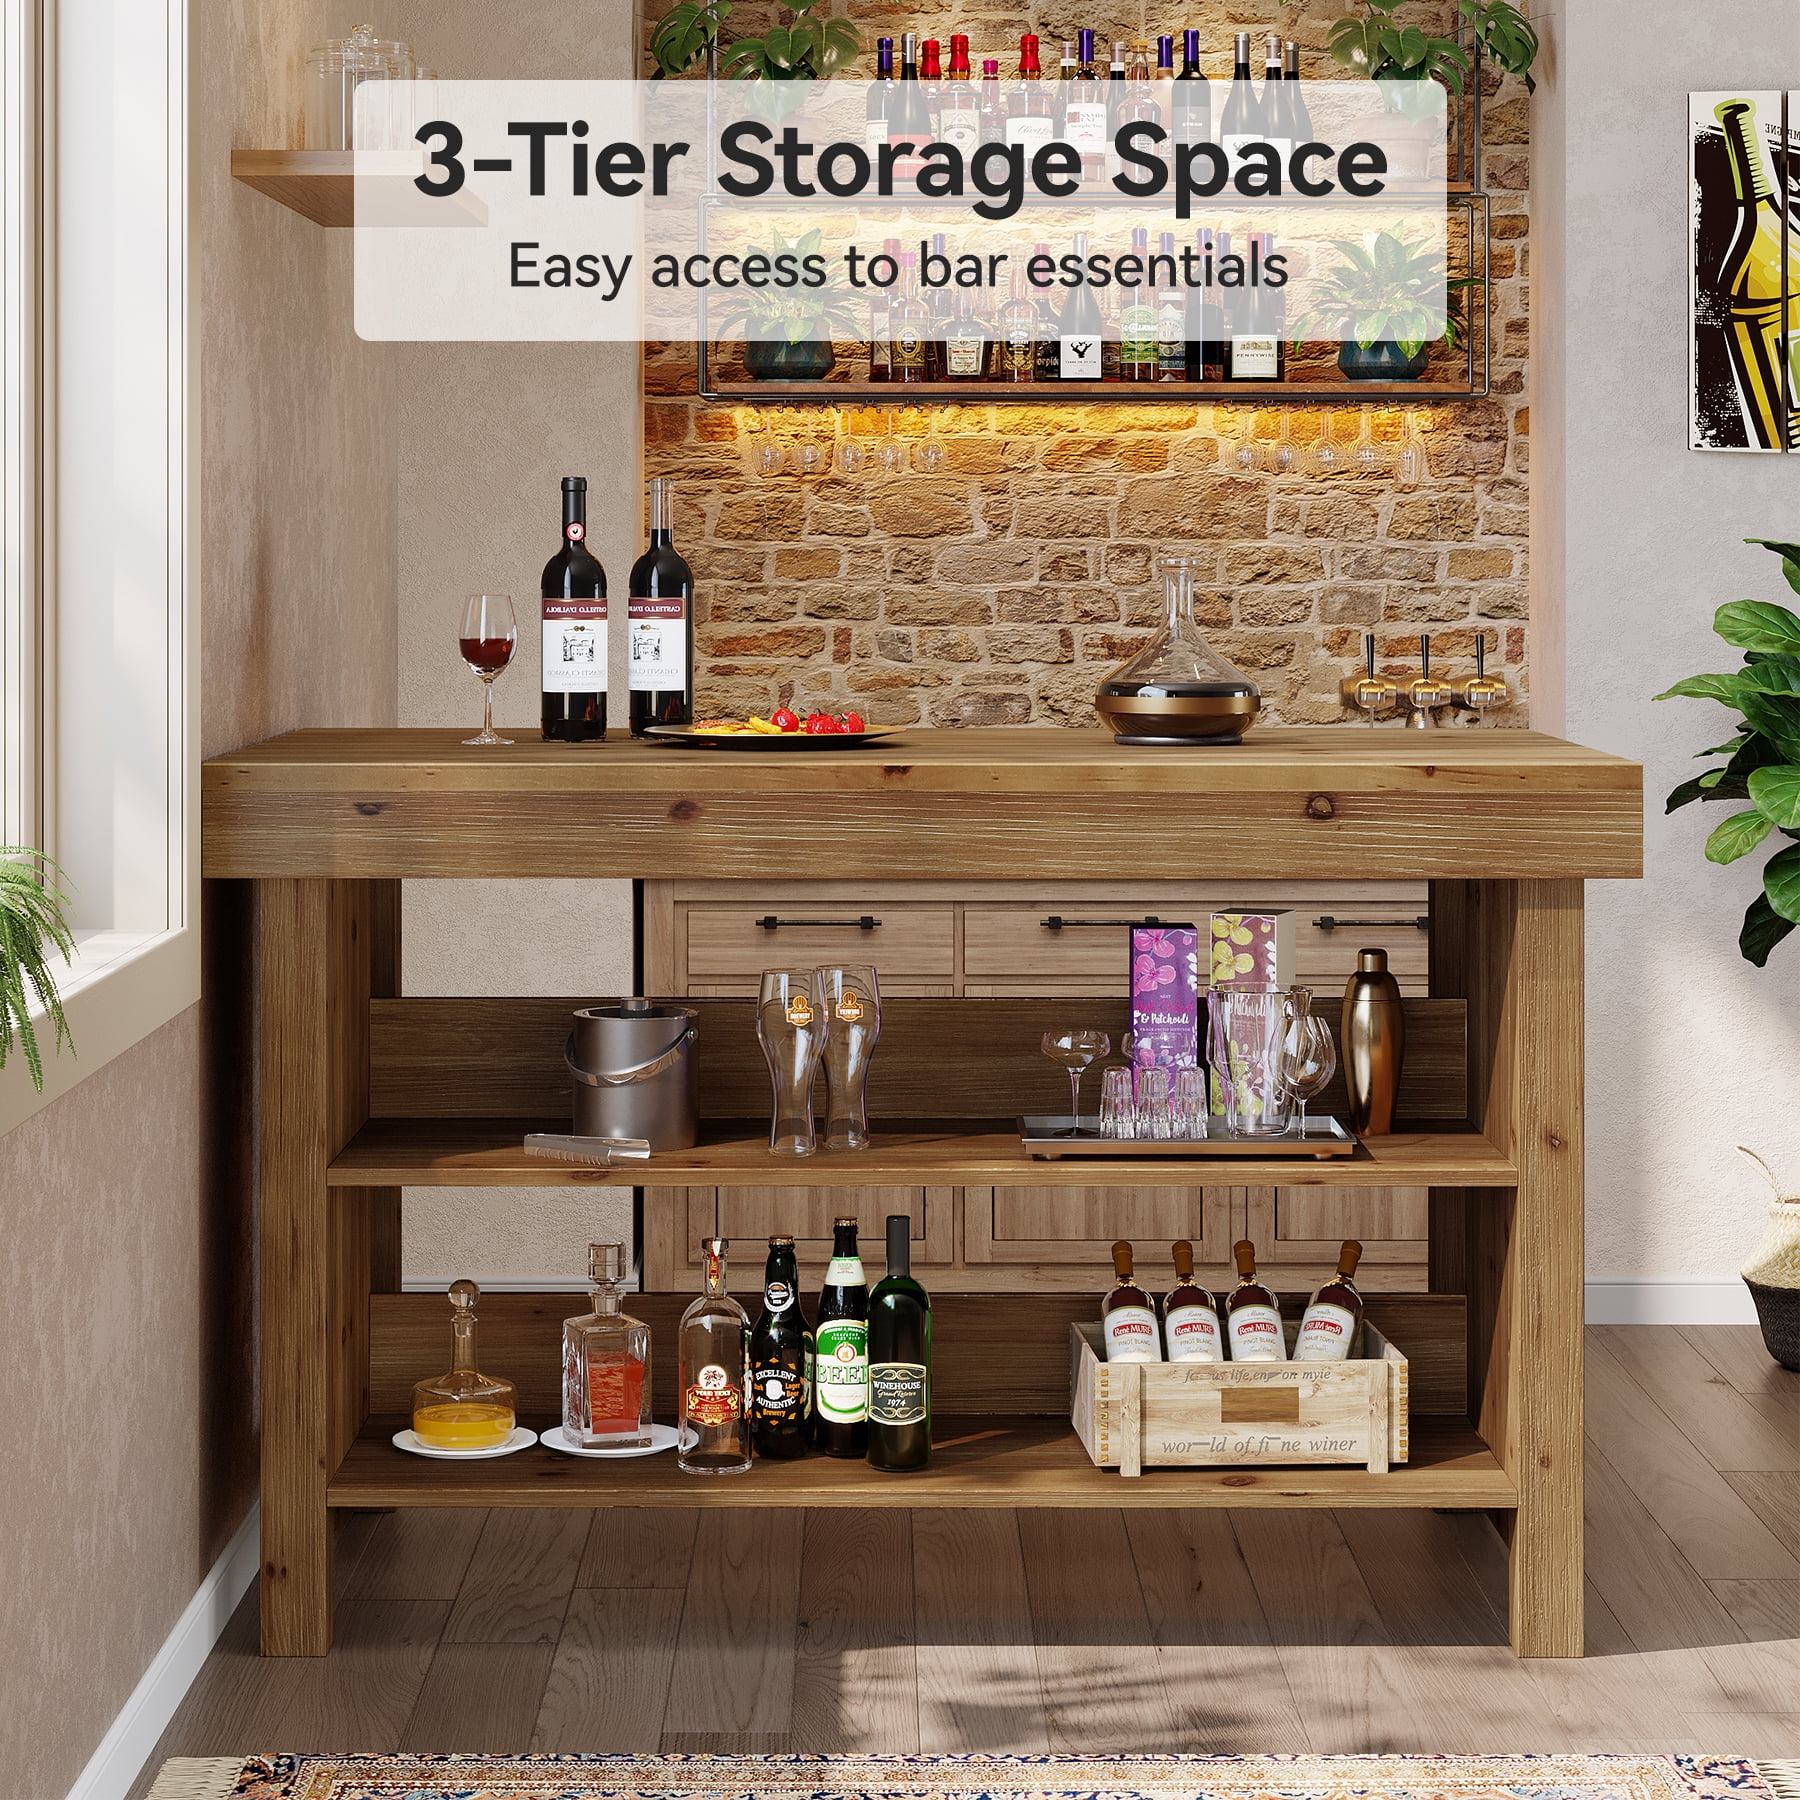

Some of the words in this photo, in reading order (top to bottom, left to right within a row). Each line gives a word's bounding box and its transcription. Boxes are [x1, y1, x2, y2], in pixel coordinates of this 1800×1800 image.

[1141, 1013, 1149, 1024] &
[1151, 1012, 1189, 1025] Patchouli
[755, 1369, 796, 1381] EXCELLENT
[785, 1382, 800, 1391] Lager
[872, 1380, 921, 1390] WINEHOUSE
[786, 1390, 799, 1398] Beer
[755, 1395, 796, 1409] AUTHENTIC
[887, 1398, 906, 1407] 1974
[1234, 1435, 1255, 1456] of
[1309, 1436, 1357, 1452] winer
